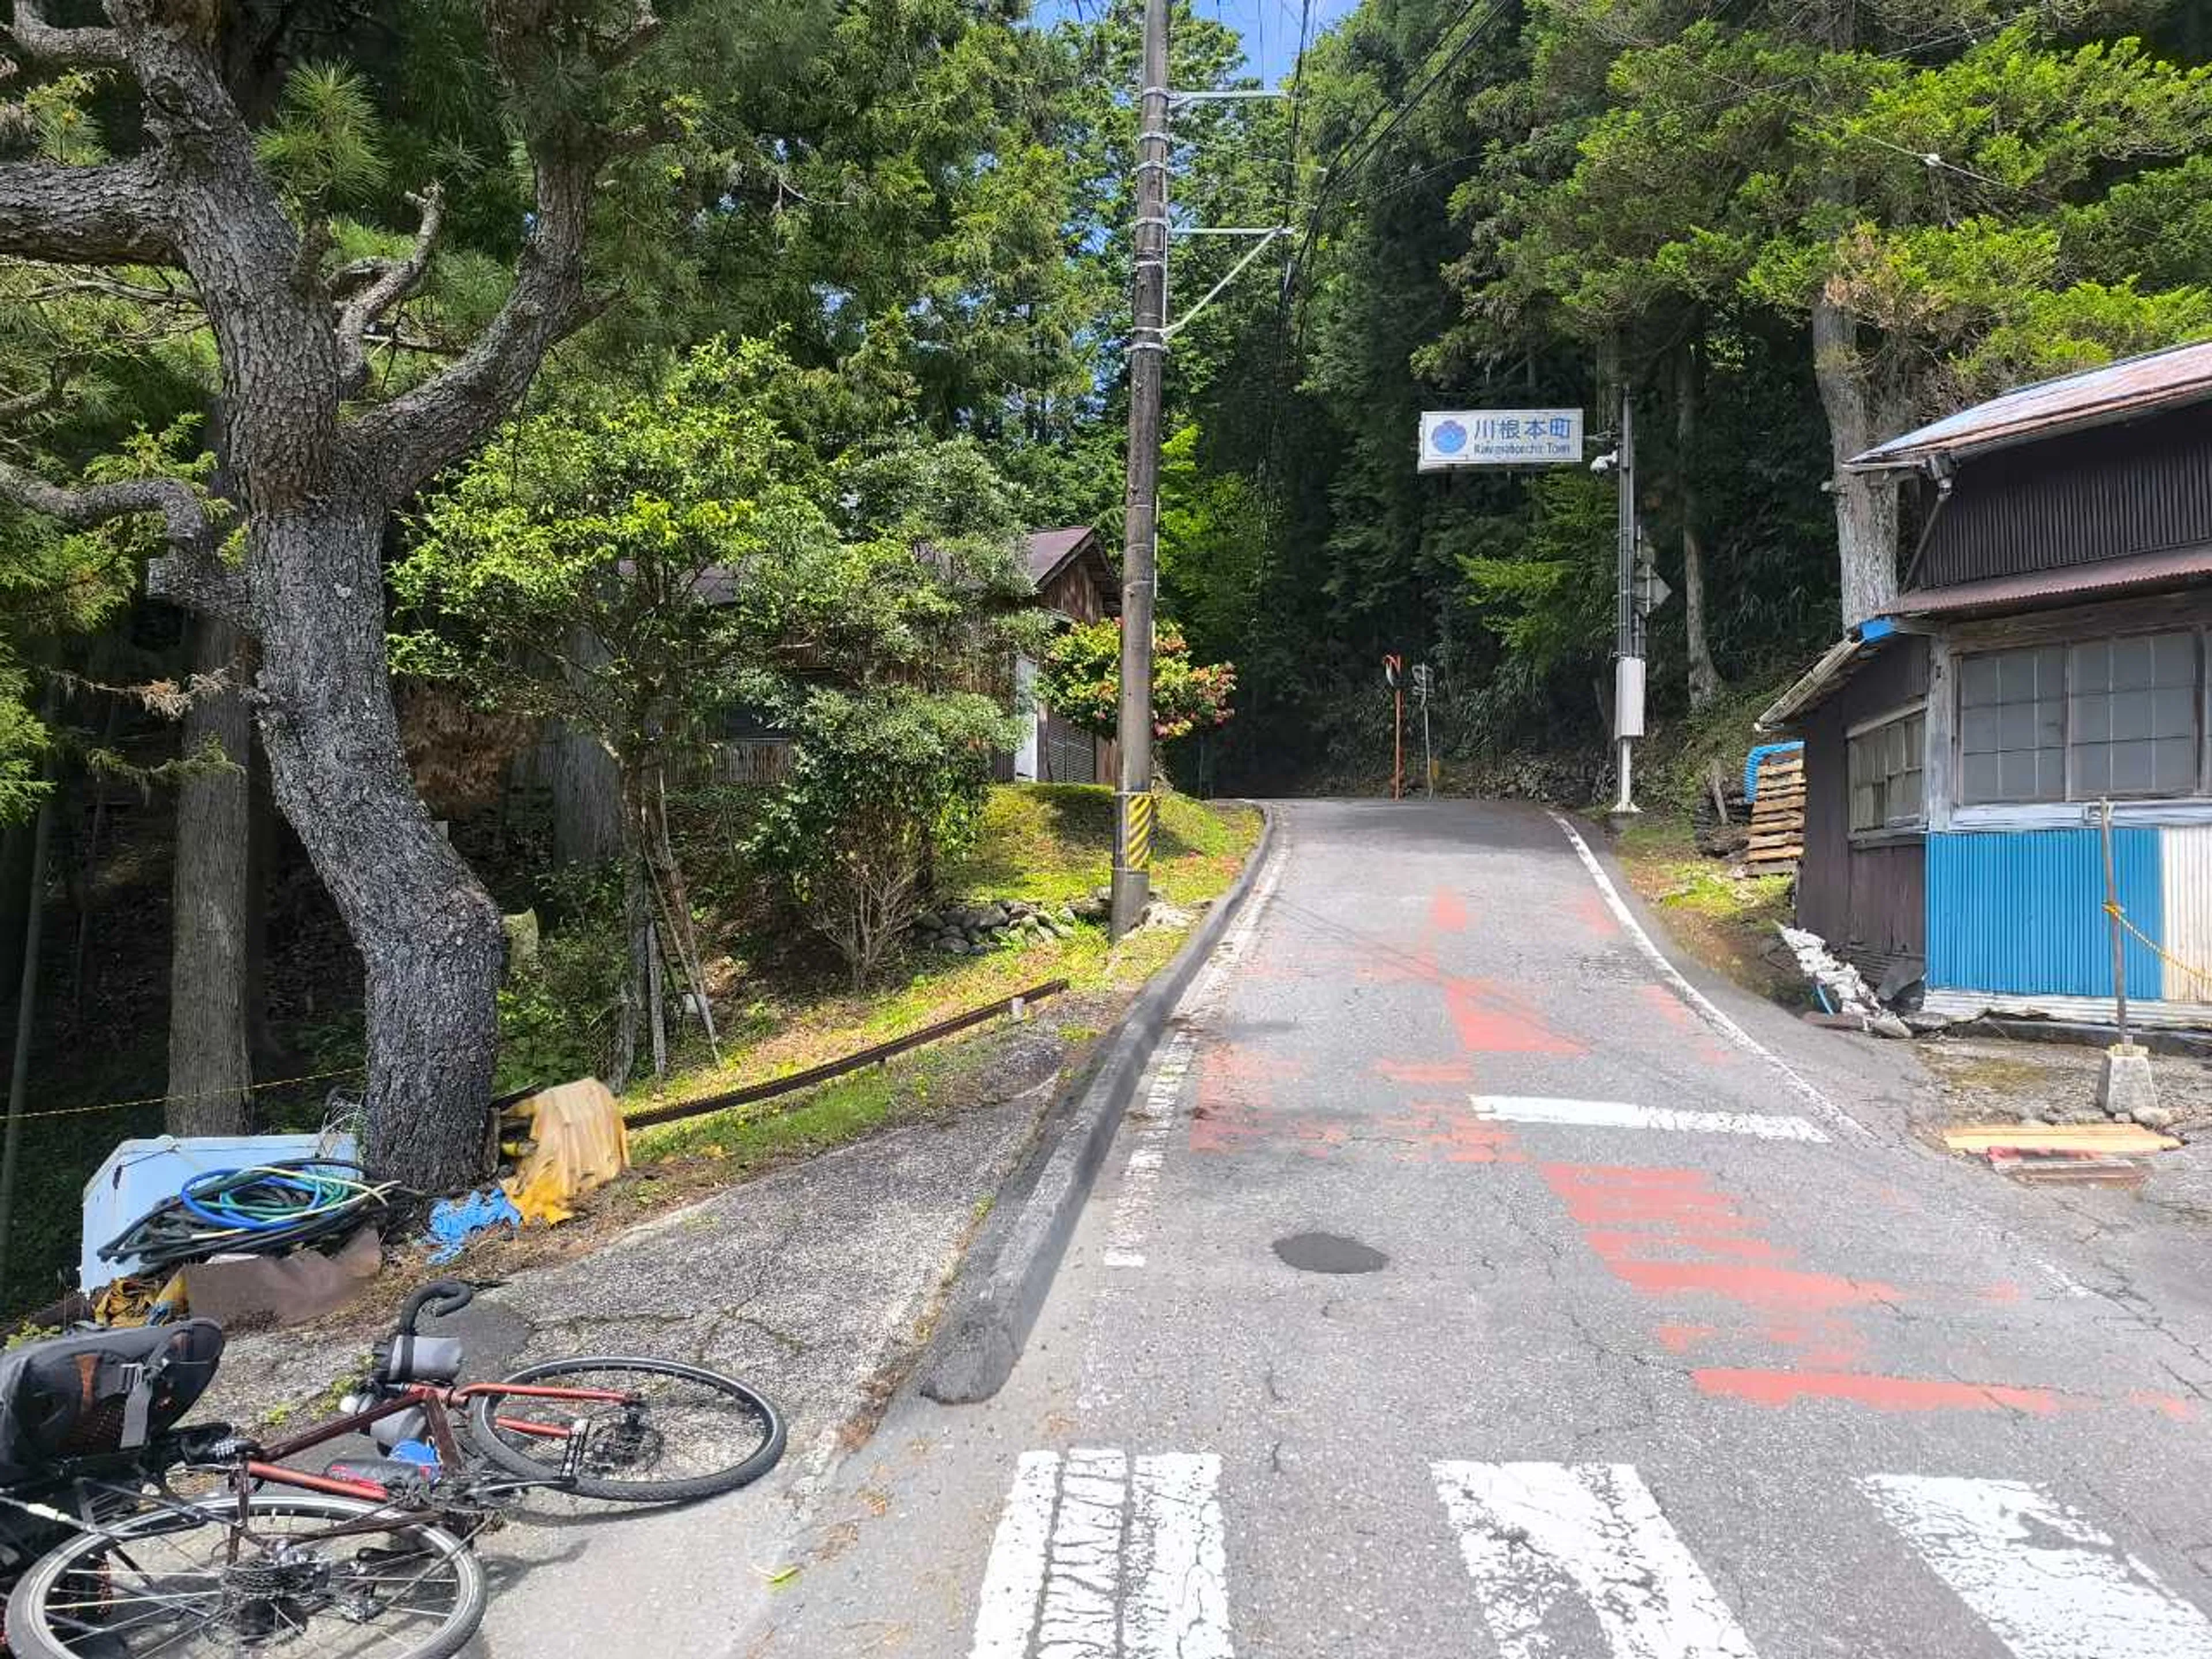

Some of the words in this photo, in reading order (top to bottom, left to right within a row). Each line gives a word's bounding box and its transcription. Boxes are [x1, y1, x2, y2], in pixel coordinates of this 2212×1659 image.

[1474, 418, 1572, 440] 川根本町
[1547, 442, 1570, 453] Town
